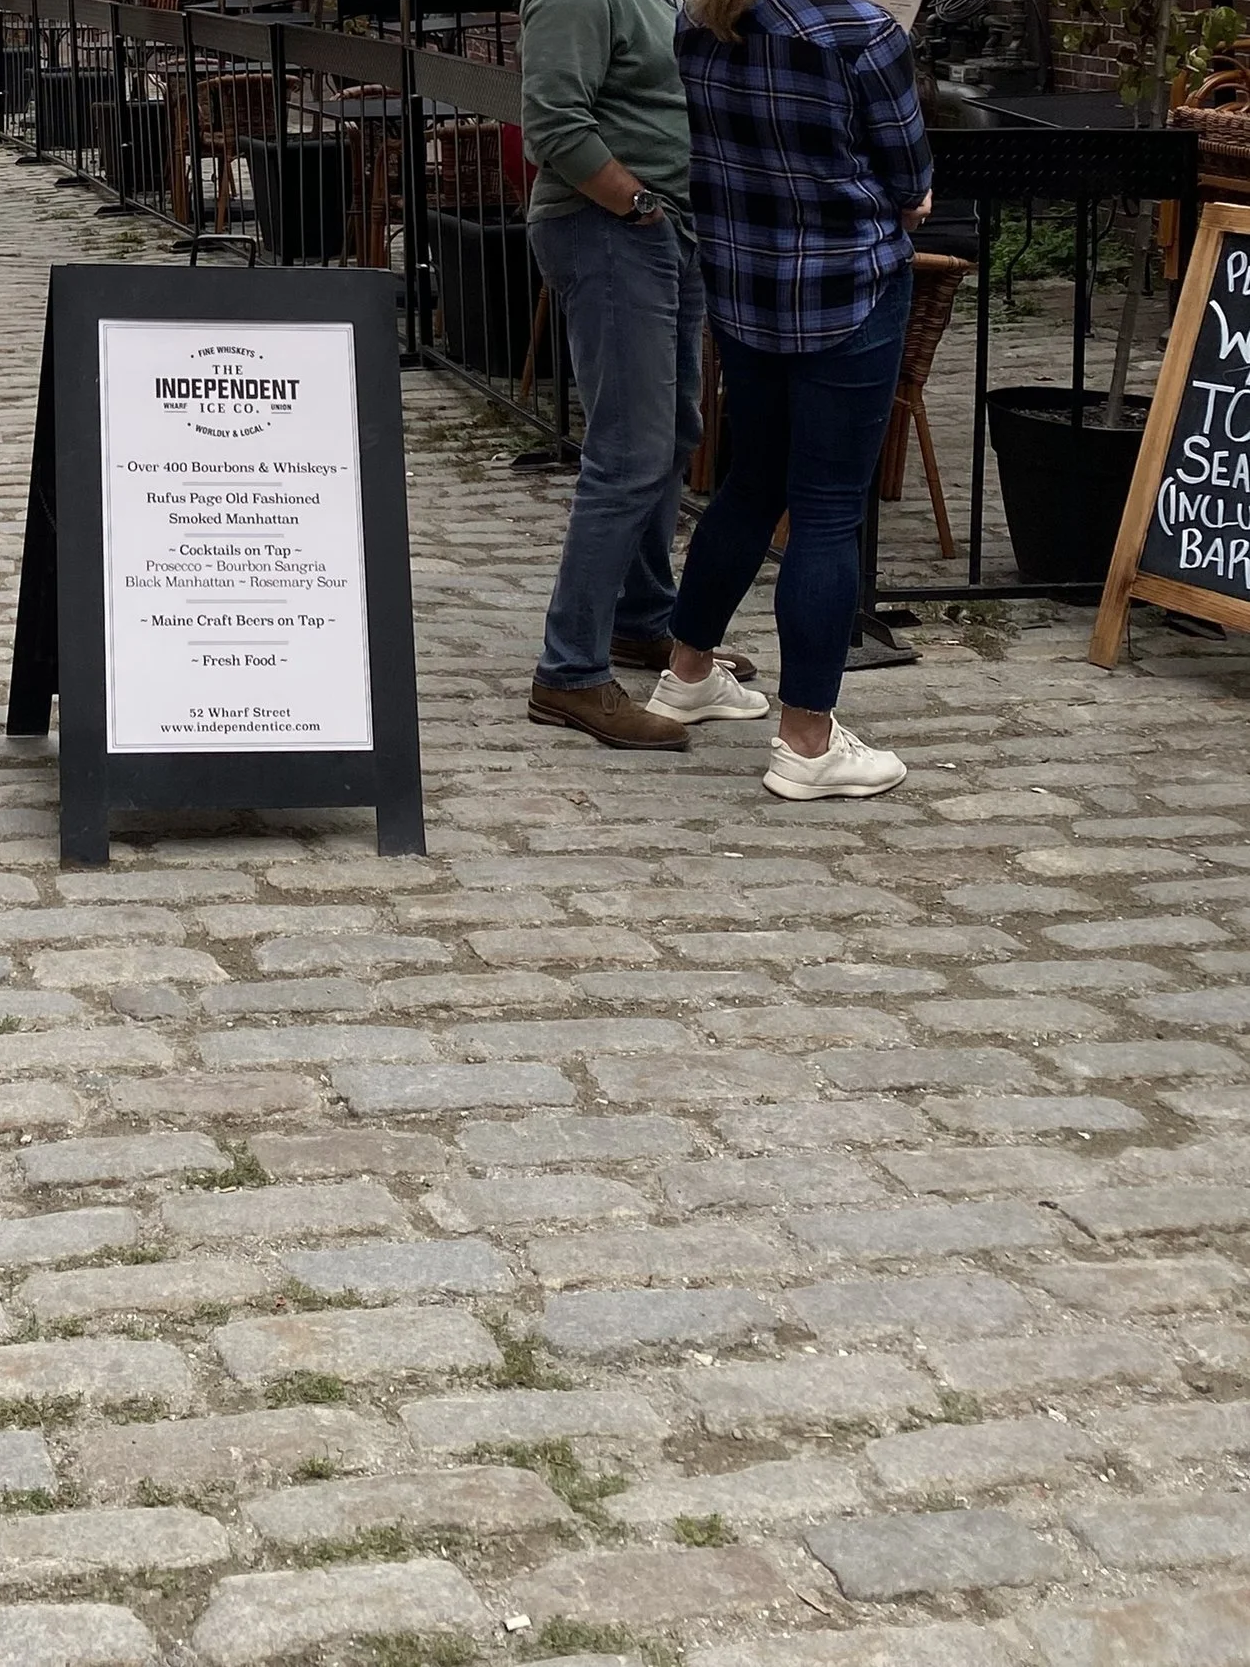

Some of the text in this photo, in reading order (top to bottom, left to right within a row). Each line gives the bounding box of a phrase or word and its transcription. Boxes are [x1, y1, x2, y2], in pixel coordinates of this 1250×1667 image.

[198, 346, 255, 358] FINE WHISKEYS
[212, 364, 243, 375] THE
[155, 377, 300, 400] INDEPENDENT
[200, 403, 225, 413] ICE
[234, 403, 259, 414] CO.
[195, 424, 231, 438] WORLDLY
[241, 424, 264, 437] LOCAL
[128, 461, 337, 476] Over 400 Bourbons & Whiskeys
[147, 492, 320, 507] Rufus Page Old Fashioned
[169, 513, 299, 525] Smoked Manhattan
[180, 544, 291, 558] Cocktails on Tap
[1180, 528, 1250, 590] BAR
[146, 560, 326, 574] Prosecco Bourbon Sangria
[126, 575, 348, 590] Black Manhattan Rosemary Sour
[152, 614, 324, 629] Maine Craft Beers on Tap
[203, 654, 276, 666] Fresh Food
[190, 707, 290, 718] 52 Wharf Street
[161, 721, 320, 734] www.independentice.com
